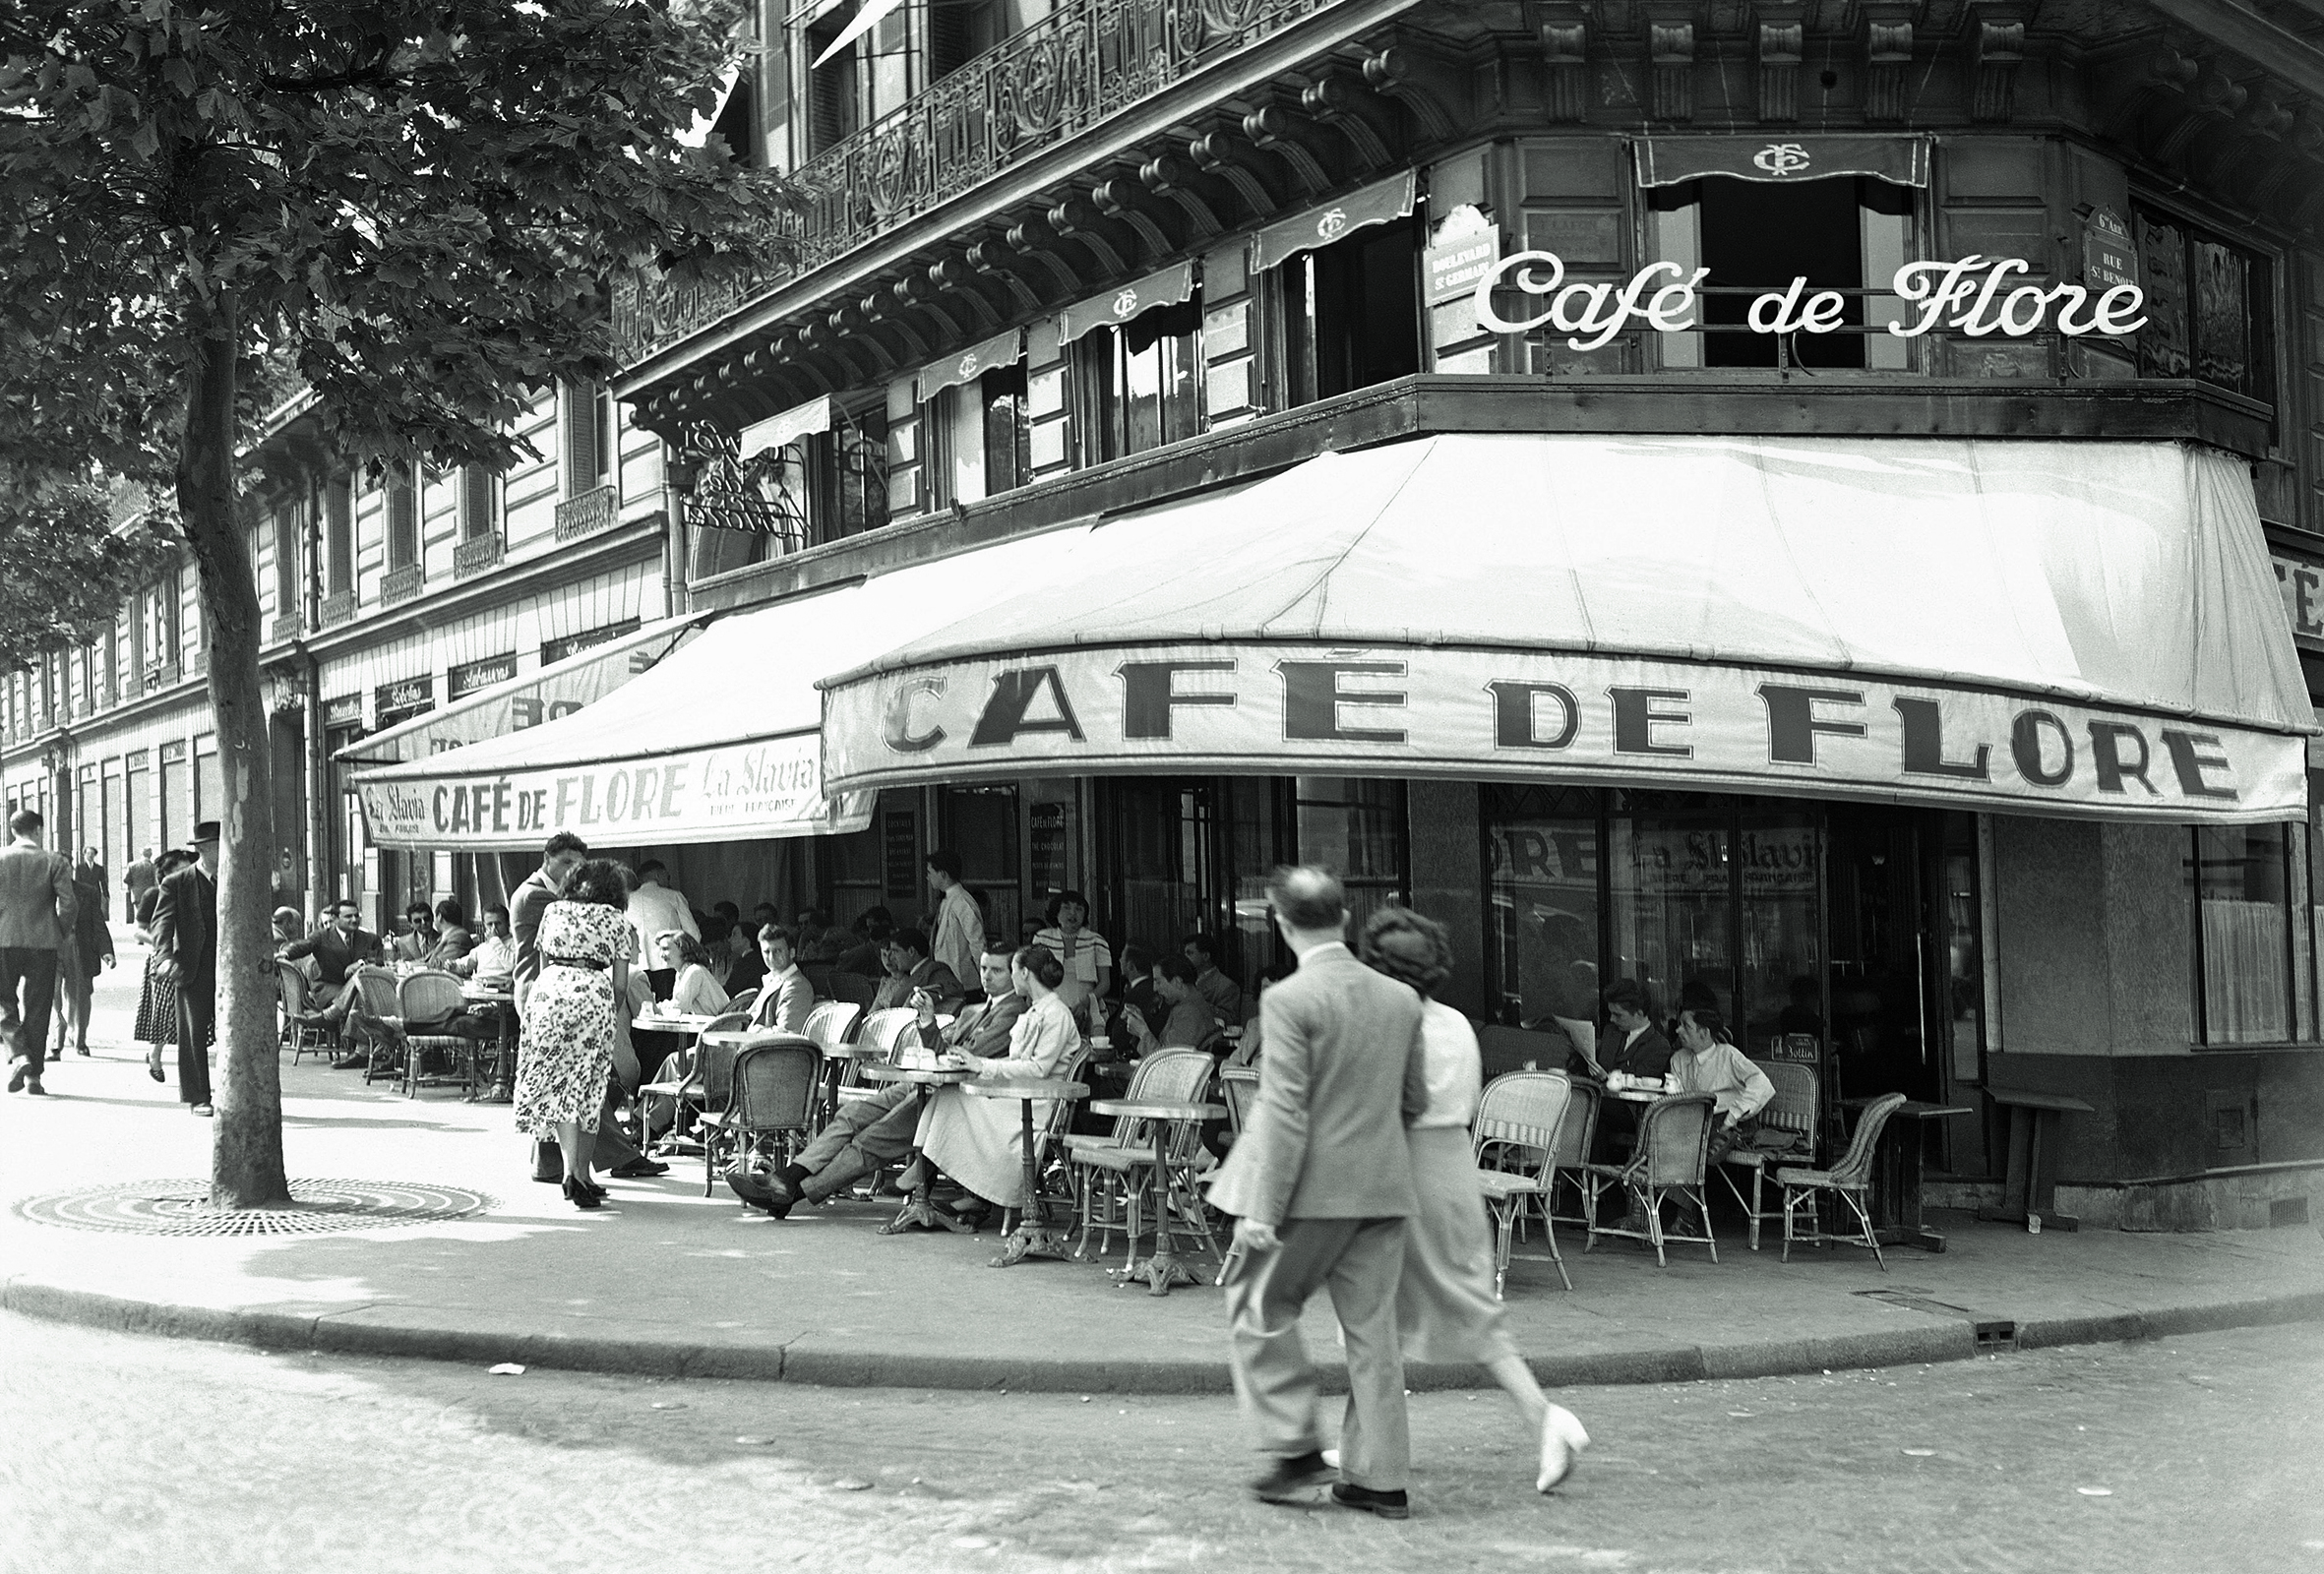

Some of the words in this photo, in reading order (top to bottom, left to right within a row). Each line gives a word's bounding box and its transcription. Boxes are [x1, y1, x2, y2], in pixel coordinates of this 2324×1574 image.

[2102, 252, 2123, 271] RUE
[2103, 270, 2135, 286] BENOIT
[1475, 250, 1711, 352] Café
[1746, 275, 1845, 334] de
[1888, 254, 2149, 338] Flore
[1483, 679, 1694, 759] DE
[1755, 680, 2241, 803] FLORE
[432, 775, 512, 834] CAFÉ
[518, 788, 547, 830] DE
[554, 762, 690, 827] FLORE
[702, 752, 730, 799] La
[736, 746, 815, 796] Slavia
[387, 783, 426, 822] Slavia
